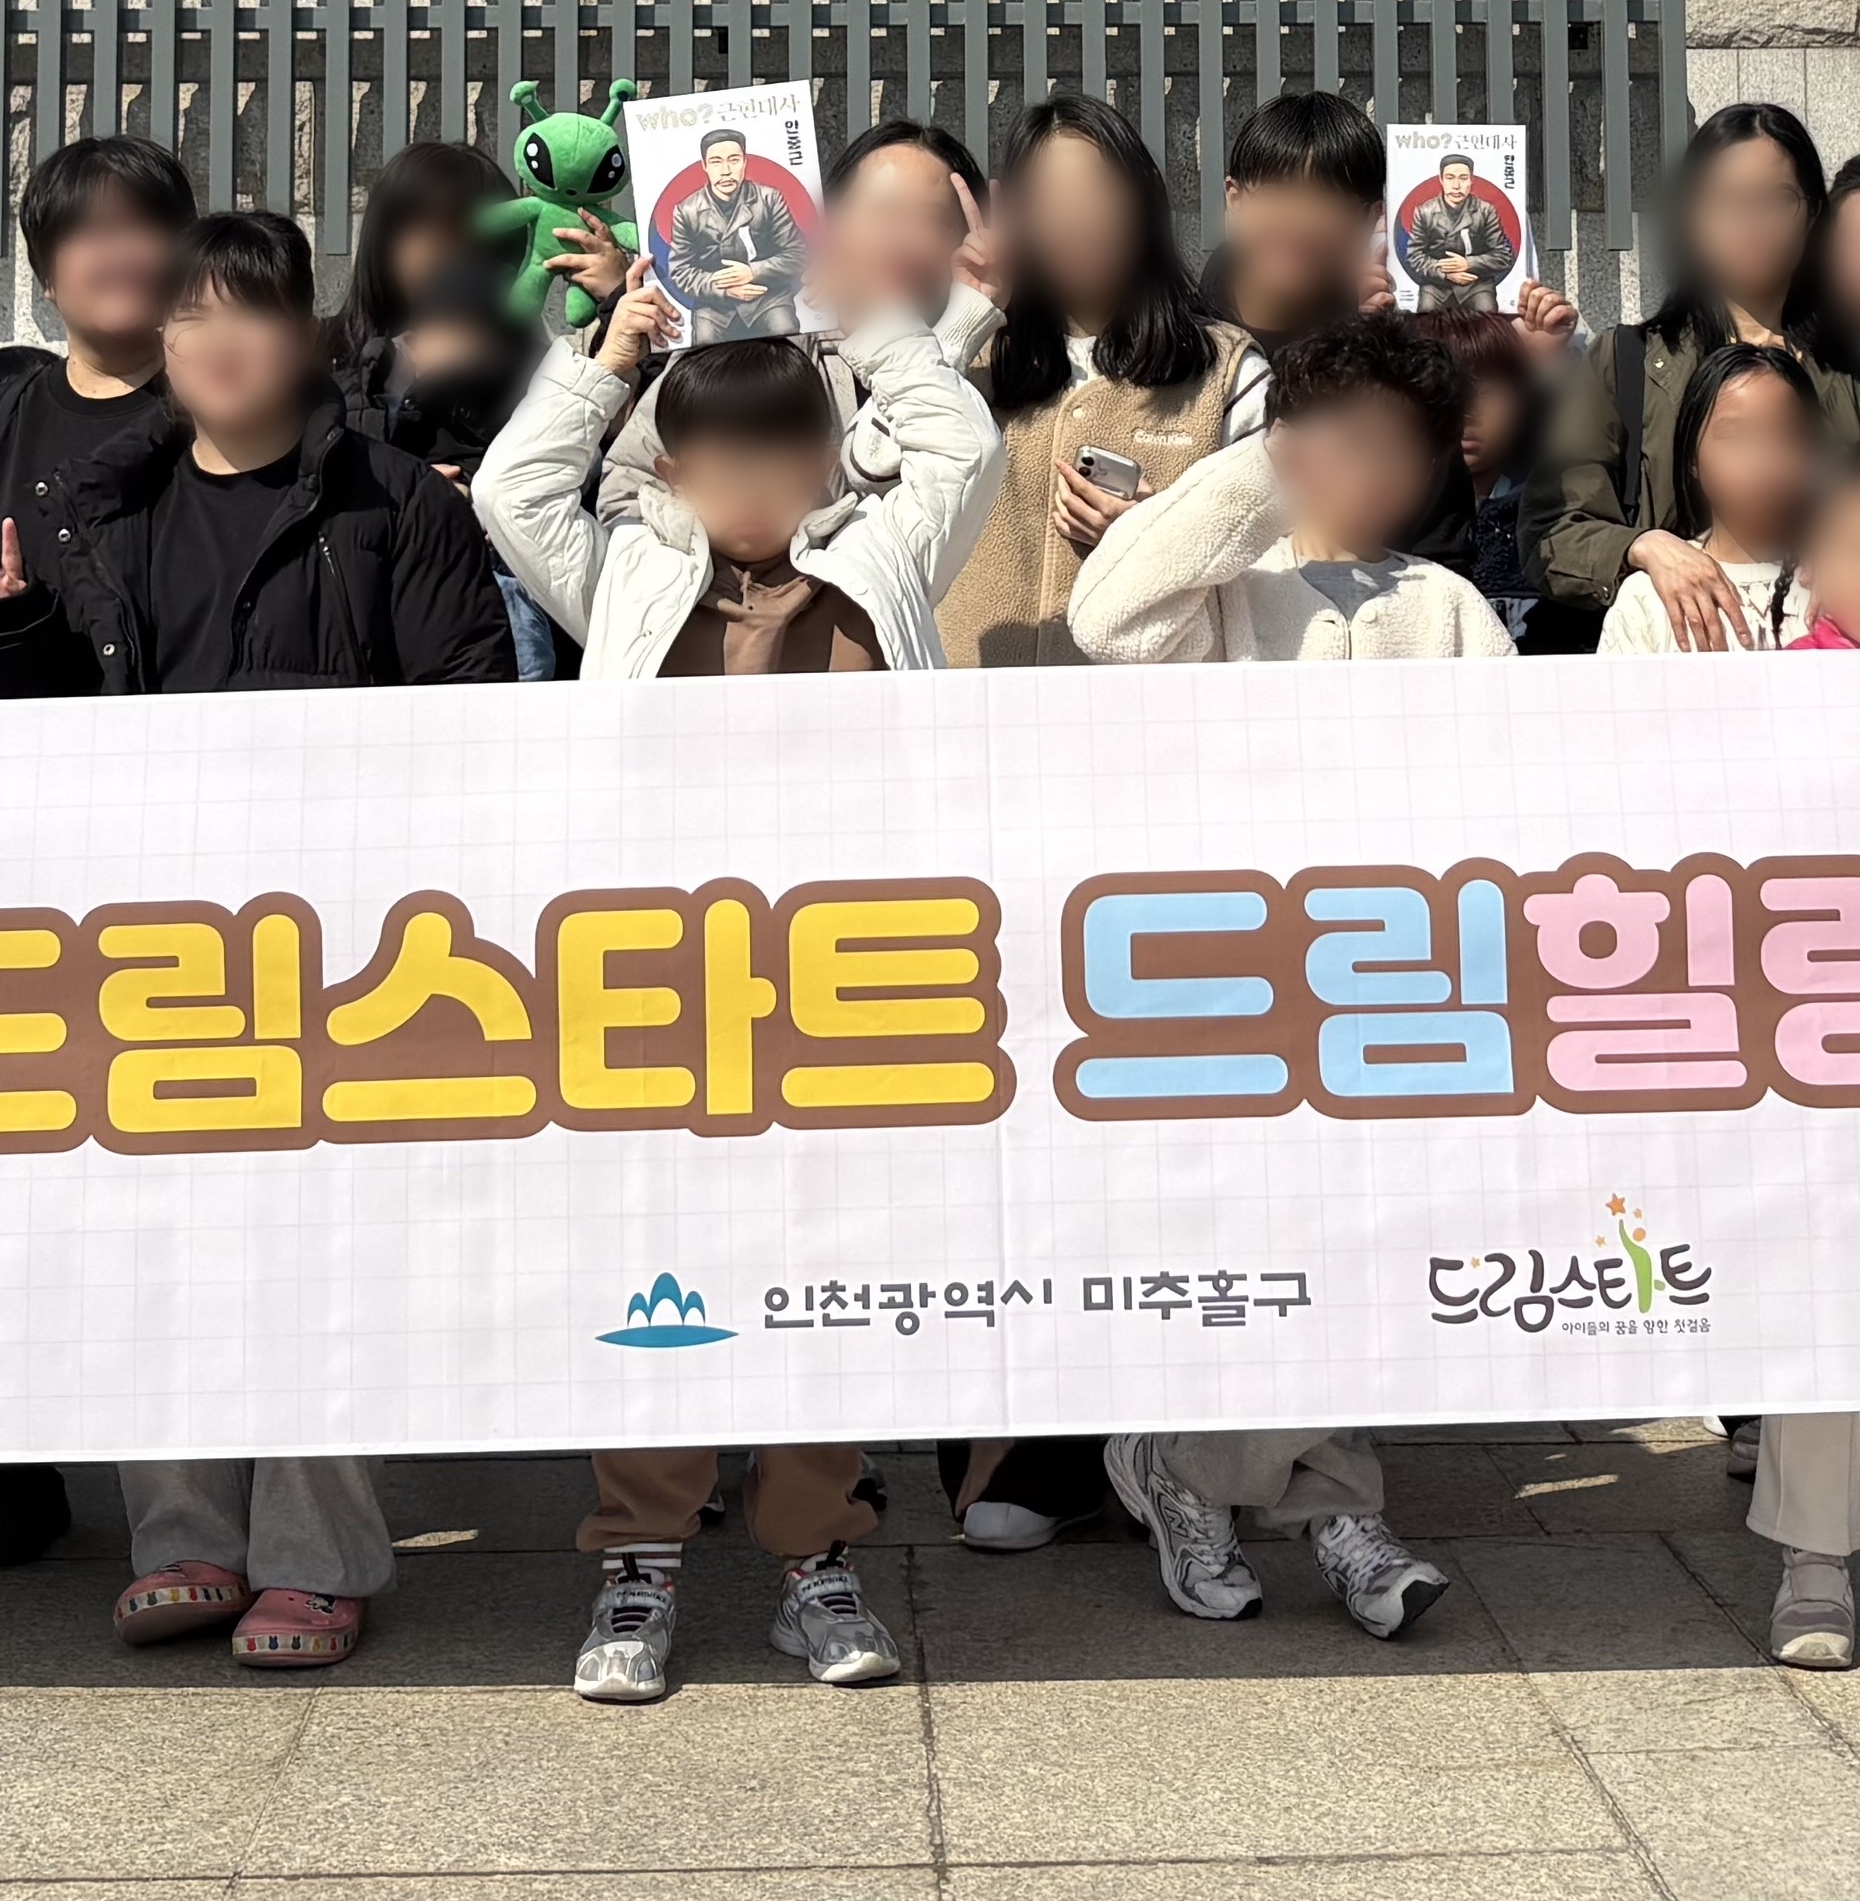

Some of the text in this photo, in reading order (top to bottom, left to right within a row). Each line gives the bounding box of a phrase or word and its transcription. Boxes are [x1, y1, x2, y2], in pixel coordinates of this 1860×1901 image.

[636, 102, 714, 131] who?
[1395, 131, 1453, 150] who?
[1428, 1220, 1712, 1334] 드림스타트
[764, 1268, 1312, 1336] 인천광역시 미추홀구
[1562, 1320, 1610, 1336] 아이들의
